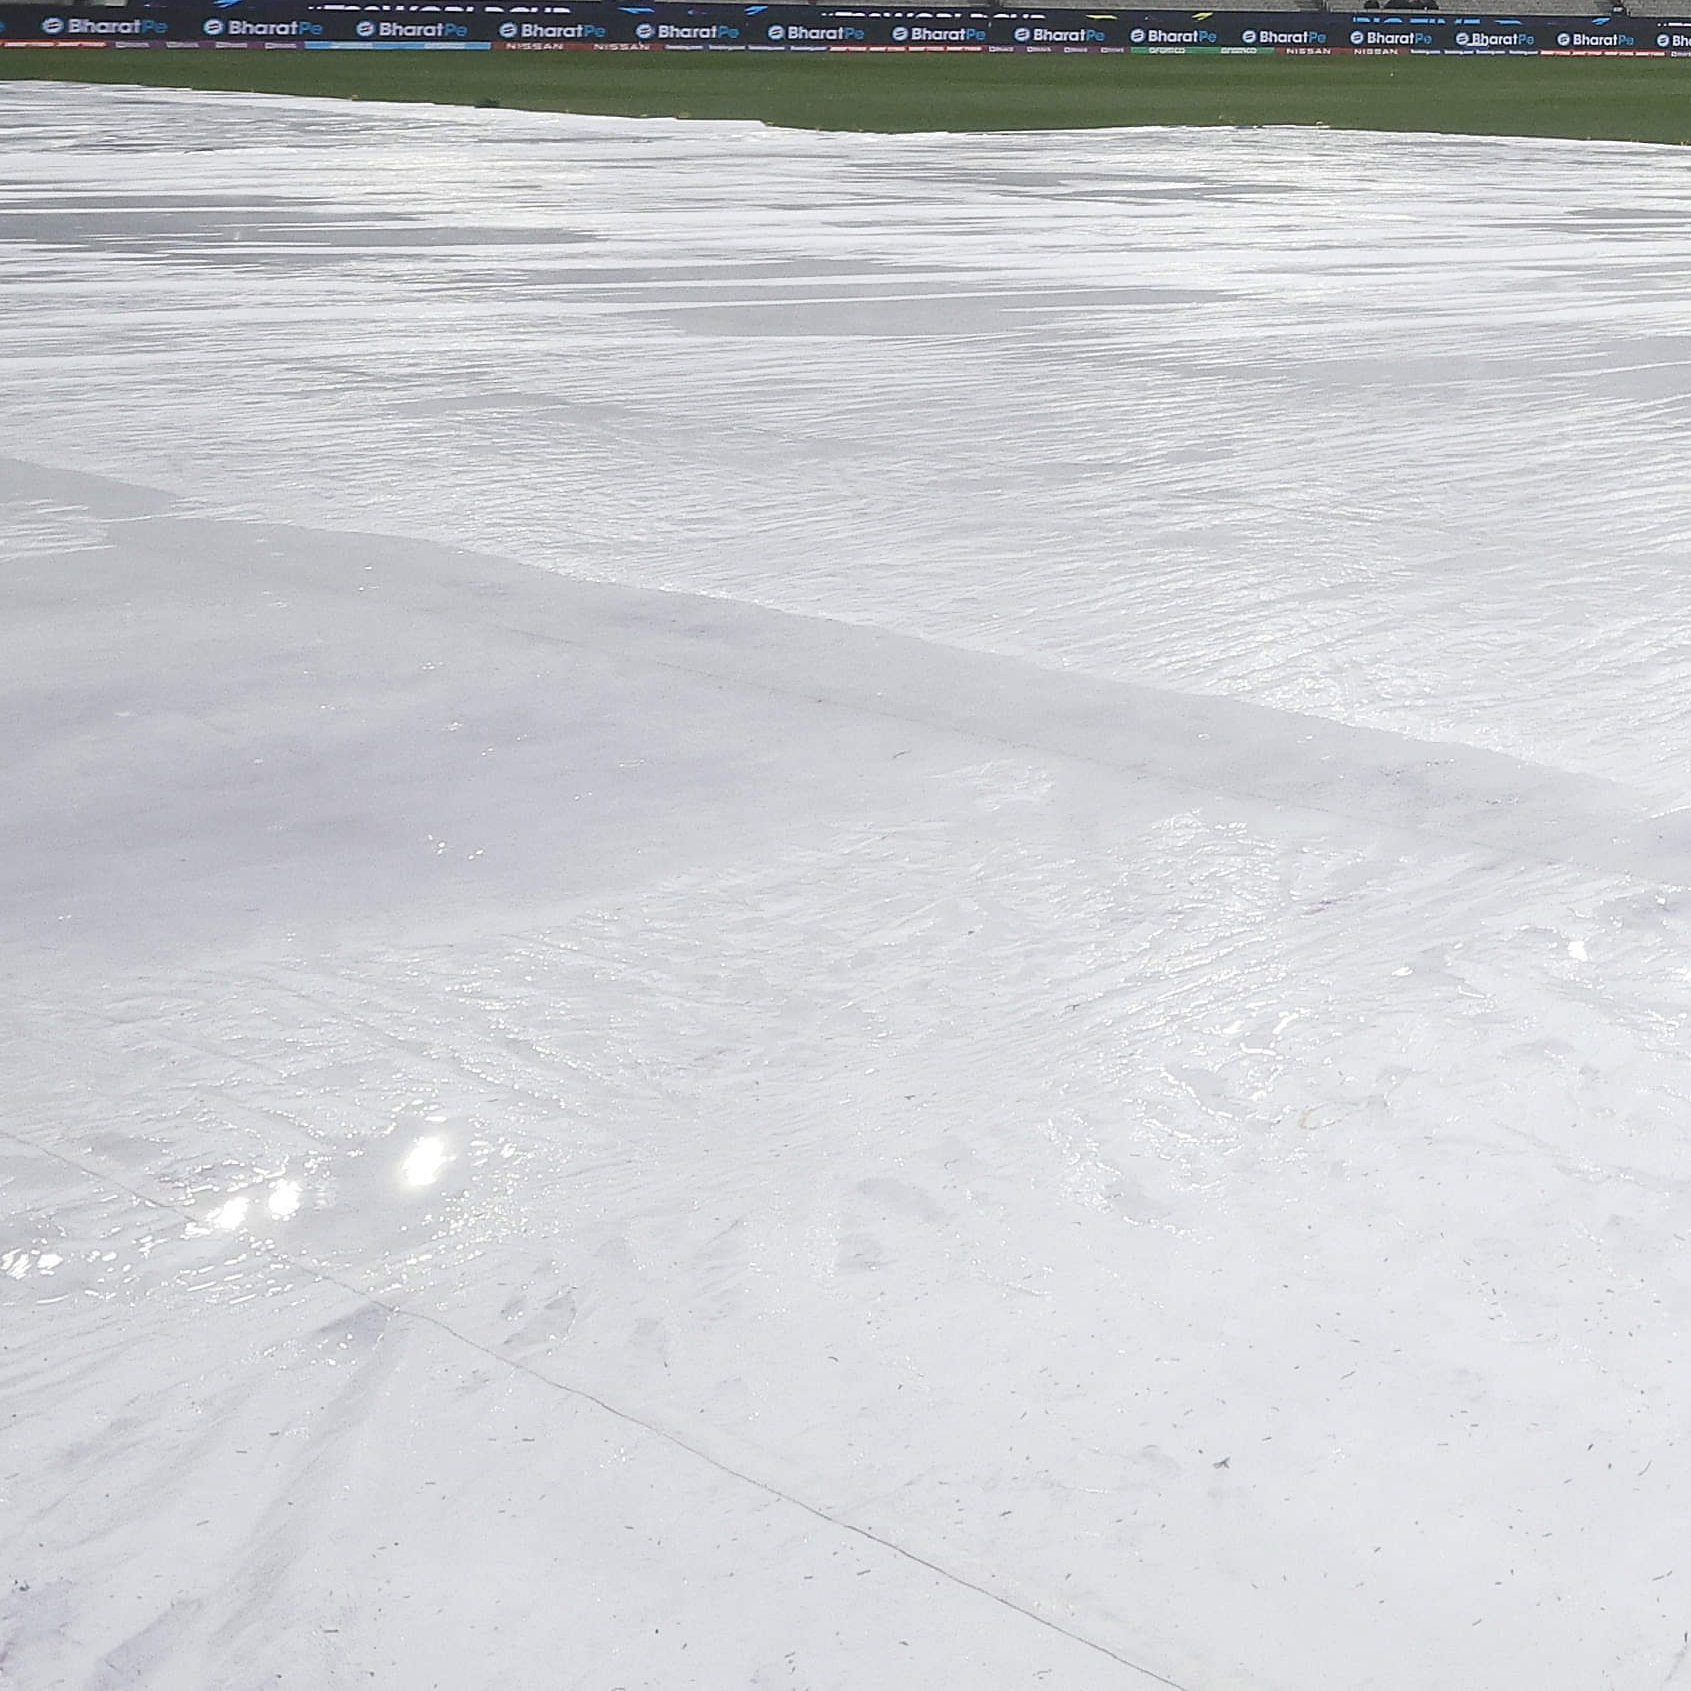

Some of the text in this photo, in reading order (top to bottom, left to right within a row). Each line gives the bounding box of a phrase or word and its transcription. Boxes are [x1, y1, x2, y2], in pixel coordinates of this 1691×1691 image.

[68, 18, 168, 35] BharatPe
[379, 22, 468, 37] BharatPe
[658, 25, 740, 39] BharatPe
[912, 28, 986, 41] BharatPe
[1148, 30, 1217, 43] BharatPe
[1367, 32, 1432, 45] BharatPe
[1573, 34, 1634, 47] BharatPe
[506, 42, 564, 50] NISSAN
